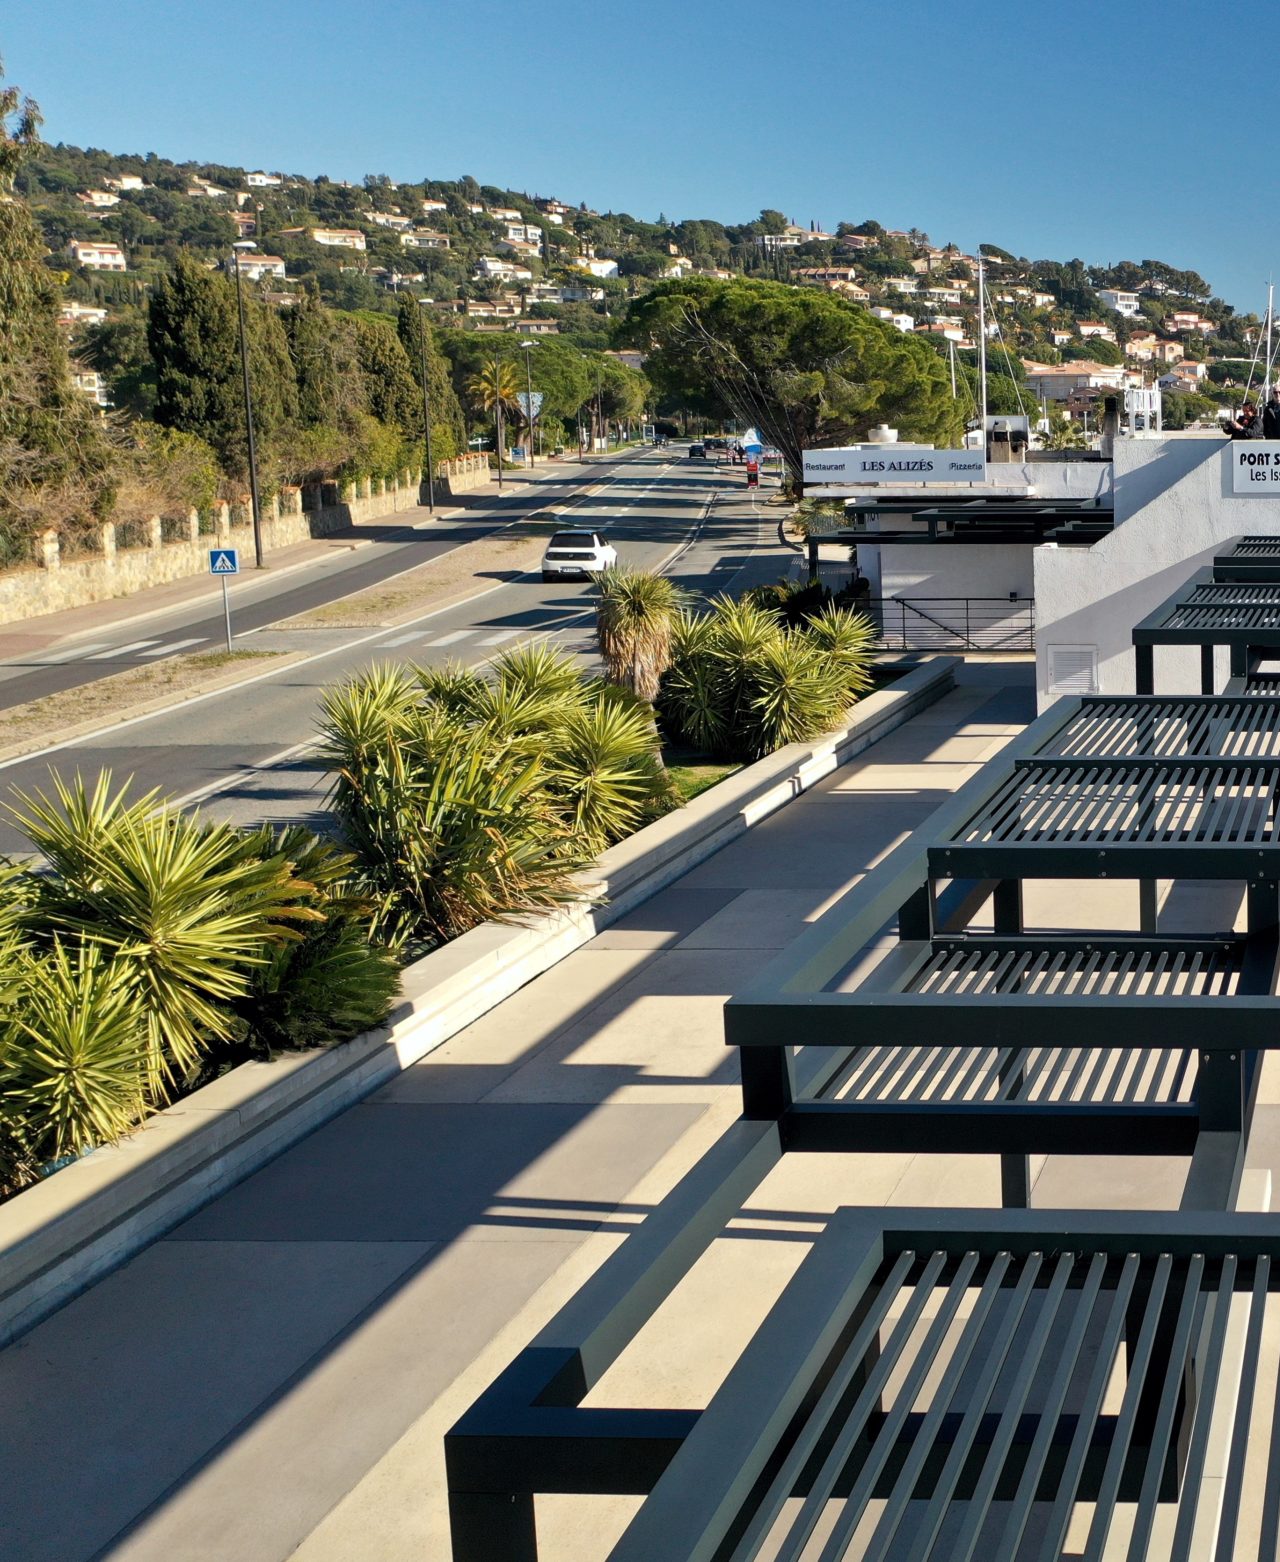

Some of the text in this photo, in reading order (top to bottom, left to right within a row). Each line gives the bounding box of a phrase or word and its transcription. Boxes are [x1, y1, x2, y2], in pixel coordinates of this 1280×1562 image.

[862, 458, 934, 471] LES ALIZÉS
[1240, 452, 1270, 466] PORT
[805, 462, 846, 471] Restaurant
[949, 462, 983, 471] Pizzeria
[1250, 468, 1267, 481] Les
